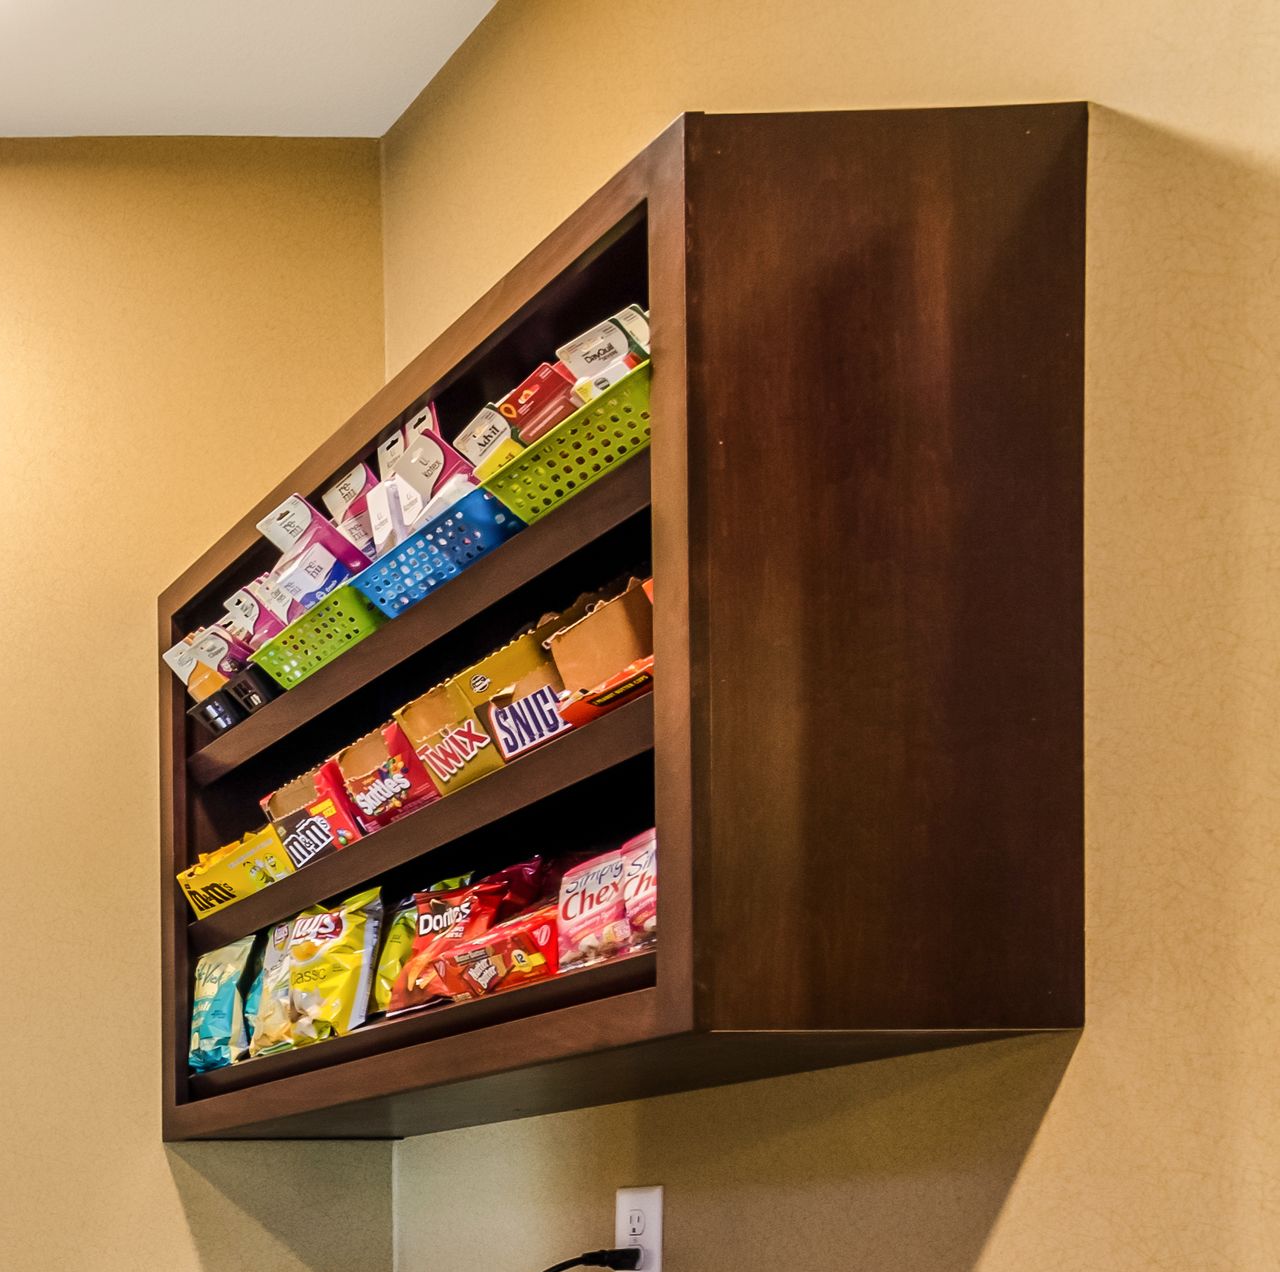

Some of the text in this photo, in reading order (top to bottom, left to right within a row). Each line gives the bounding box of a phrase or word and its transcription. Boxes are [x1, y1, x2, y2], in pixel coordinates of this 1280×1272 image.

[477, 424, 501, 449] Advil
[494, 685, 573, 754] SNIC
[355, 773, 411, 815] Skittles
[418, 902, 472, 937] Doritos
[562, 881, 620, 921] Chex
